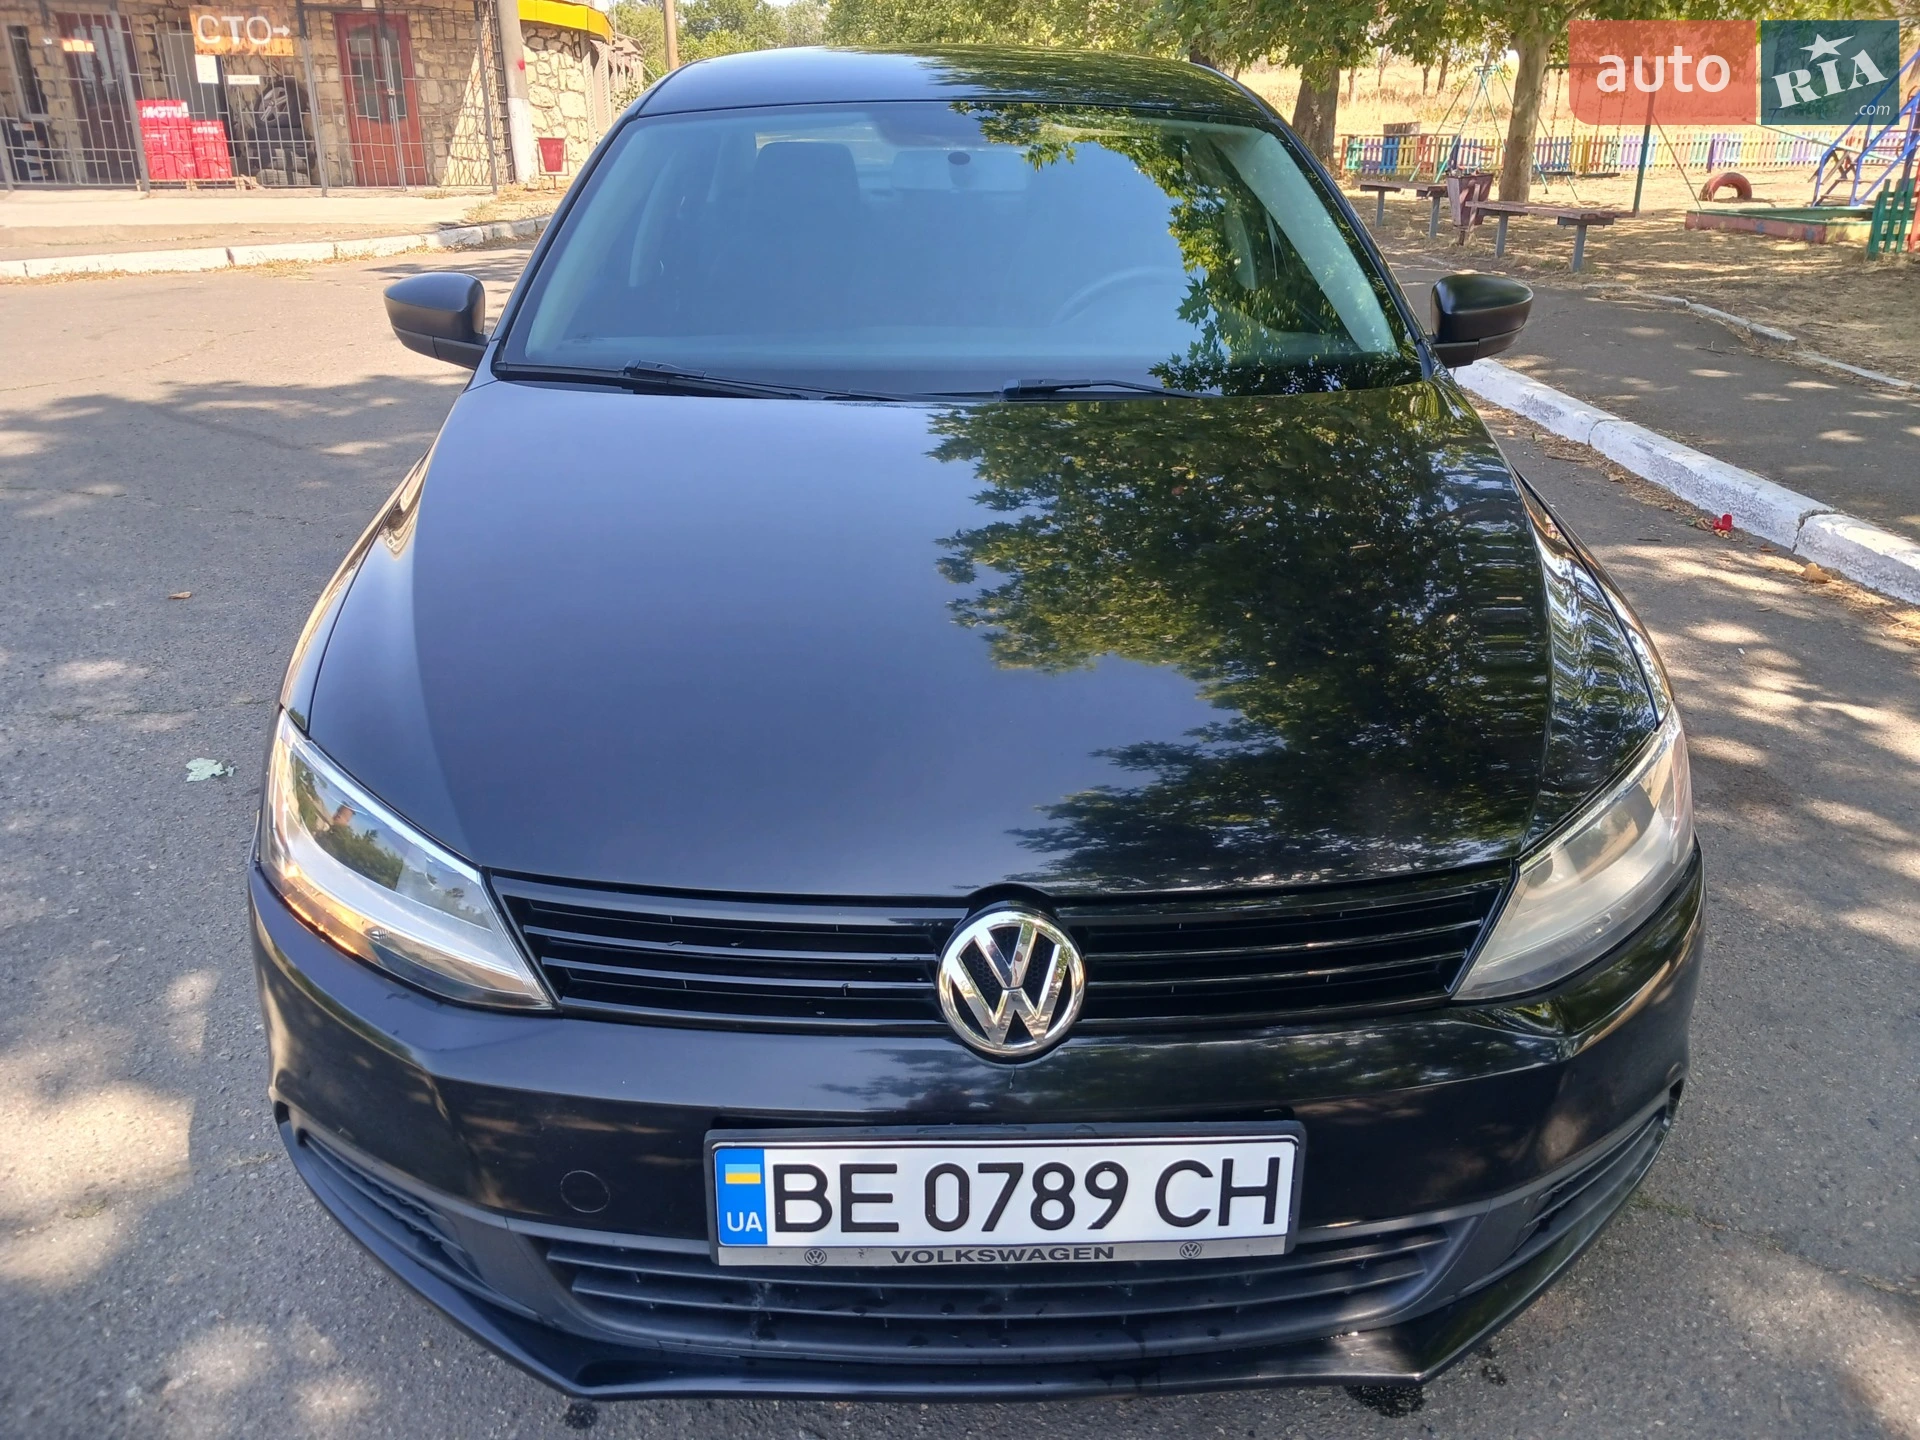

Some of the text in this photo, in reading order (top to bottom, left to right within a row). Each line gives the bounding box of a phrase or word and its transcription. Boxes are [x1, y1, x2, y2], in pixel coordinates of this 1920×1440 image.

[197, 14, 272, 45] СТО
[773, 1157, 1281, 1233] BE 0789 CH
[726, 1211, 763, 1232] UA
[891, 1246, 1114, 1264] VOLKSWAGEN
